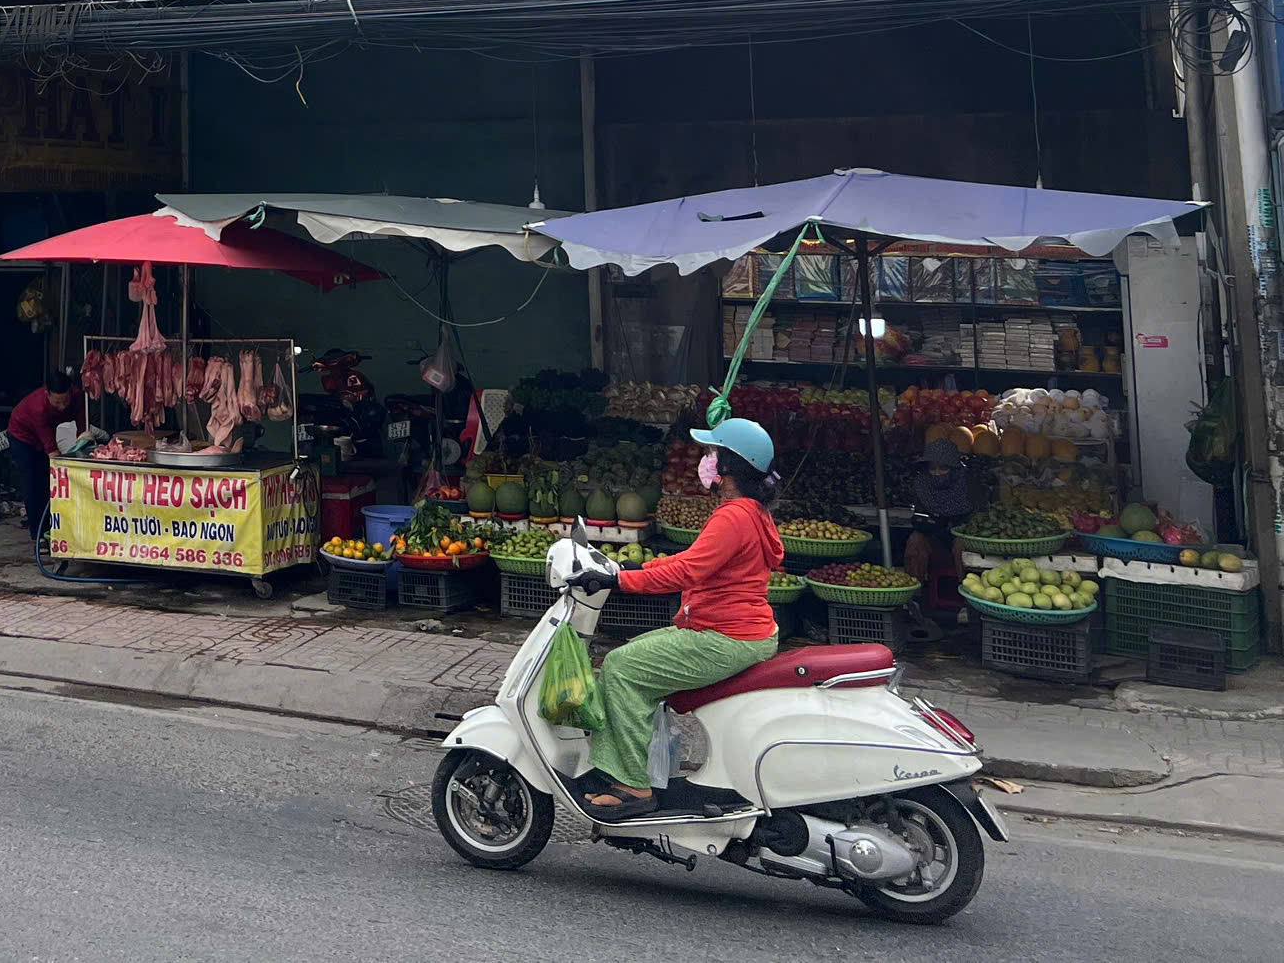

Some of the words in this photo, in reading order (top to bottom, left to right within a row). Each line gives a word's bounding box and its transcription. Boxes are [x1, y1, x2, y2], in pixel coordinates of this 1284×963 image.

[90, 469, 137, 513] THỊT
[142, 474, 185, 508] HEO
[190, 477, 247, 518] SẠCH
[104, 515, 129, 534] BAO
[172, 520, 197, 539] BAO
[200, 522, 235, 542] NGON
[51, 540, 69, 554] 36
[96, 541, 124, 557] ĐT:
[129, 544, 169, 561] 0964
[175, 548, 207, 564] 586
[212, 551, 243, 567] 336
[892, 764, 943, 782] Vespa
